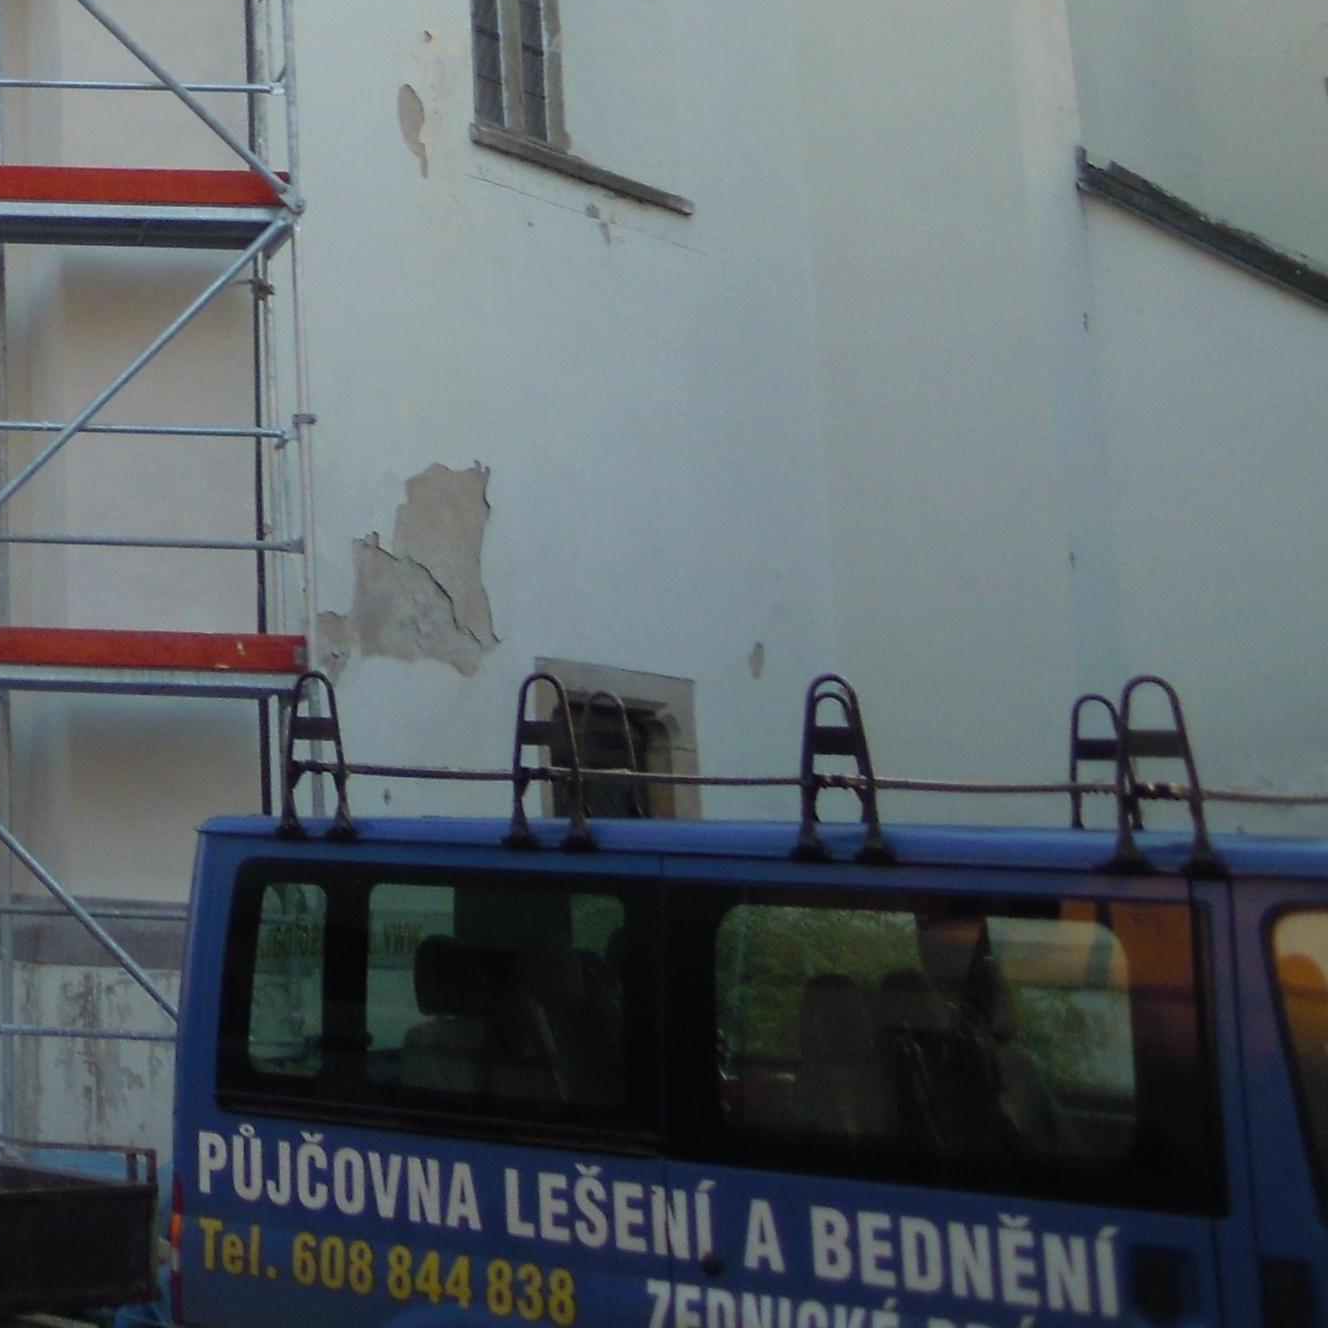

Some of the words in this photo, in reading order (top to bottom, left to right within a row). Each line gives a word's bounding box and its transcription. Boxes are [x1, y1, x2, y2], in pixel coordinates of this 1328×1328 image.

[198, 1124, 482, 1231] PŮJČOVNA
[505, 1163, 716, 1261] LEŠENÍ
[745, 1198, 784, 1273] A
[810, 1206, 1120, 1318] BEDNĚNÍ
[199, 1217, 278, 1280] Tel.
[292, 1232, 374, 1296] 608
[388, 1245, 473, 1309] 844
[487, 1256, 577, 1327] 838
